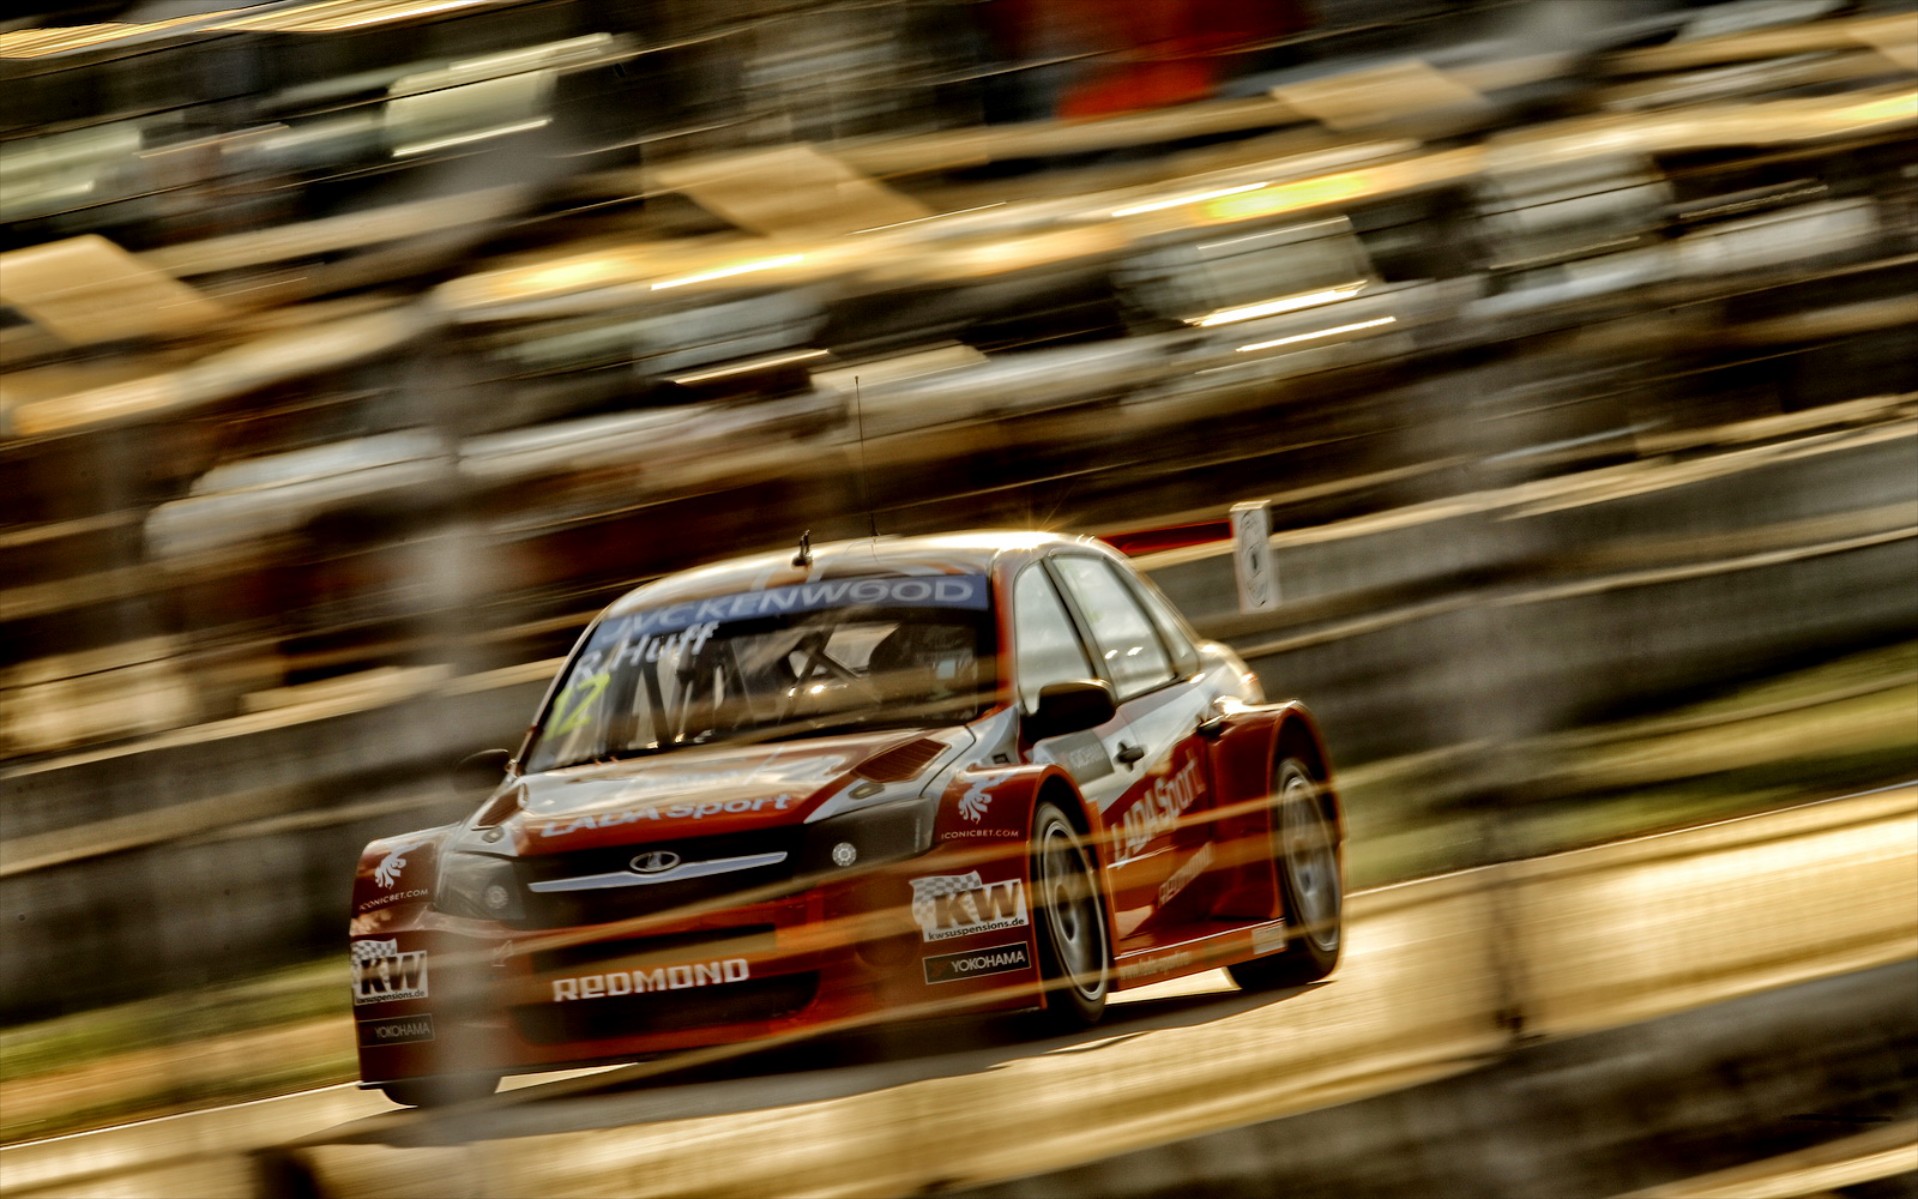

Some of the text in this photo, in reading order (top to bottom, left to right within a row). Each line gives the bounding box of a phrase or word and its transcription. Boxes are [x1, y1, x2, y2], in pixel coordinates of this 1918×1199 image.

[601, 578, 974, 644] JVCKENWOOD
[609, 620, 720, 672] Huff
[544, 672, 611, 740] 12
[541, 793, 792, 837] LADA Sport
[941, 828, 1020, 839] ICONICBET.COM
[933, 881, 1021, 931] KW
[928, 917, 1026, 941] kwsuspensions.de
[360, 952, 426, 995] KW
[951, 950, 1026, 973] YOKOHAMA
[373, 1021, 431, 1039] YOKOHAMA
